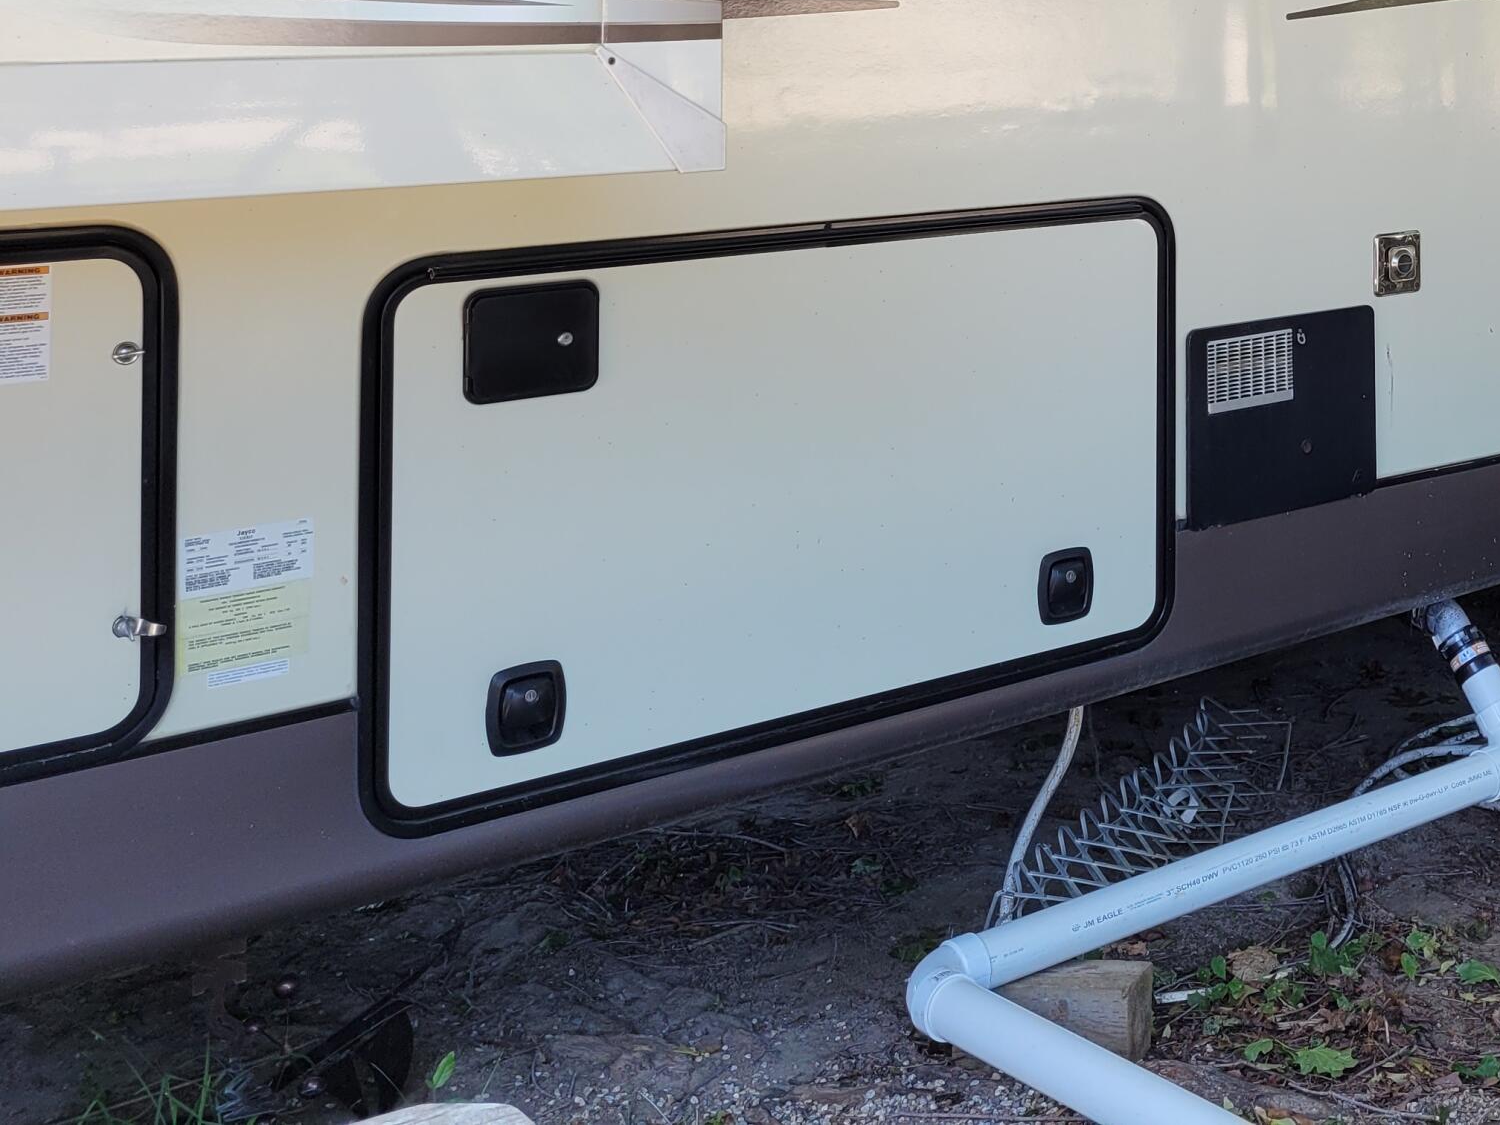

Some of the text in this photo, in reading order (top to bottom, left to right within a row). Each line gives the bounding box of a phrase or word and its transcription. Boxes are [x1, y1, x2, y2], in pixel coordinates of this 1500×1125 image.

[1083, 918, 1095, 929] JM
[1096, 908, 1124, 924] EAGLE
[1176, 878, 1201, 893] SCH40
[1202, 870, 1219, 883] DWV
[1268, 846, 1281, 857] PSI
[1307, 830, 1327, 842] ASTM
